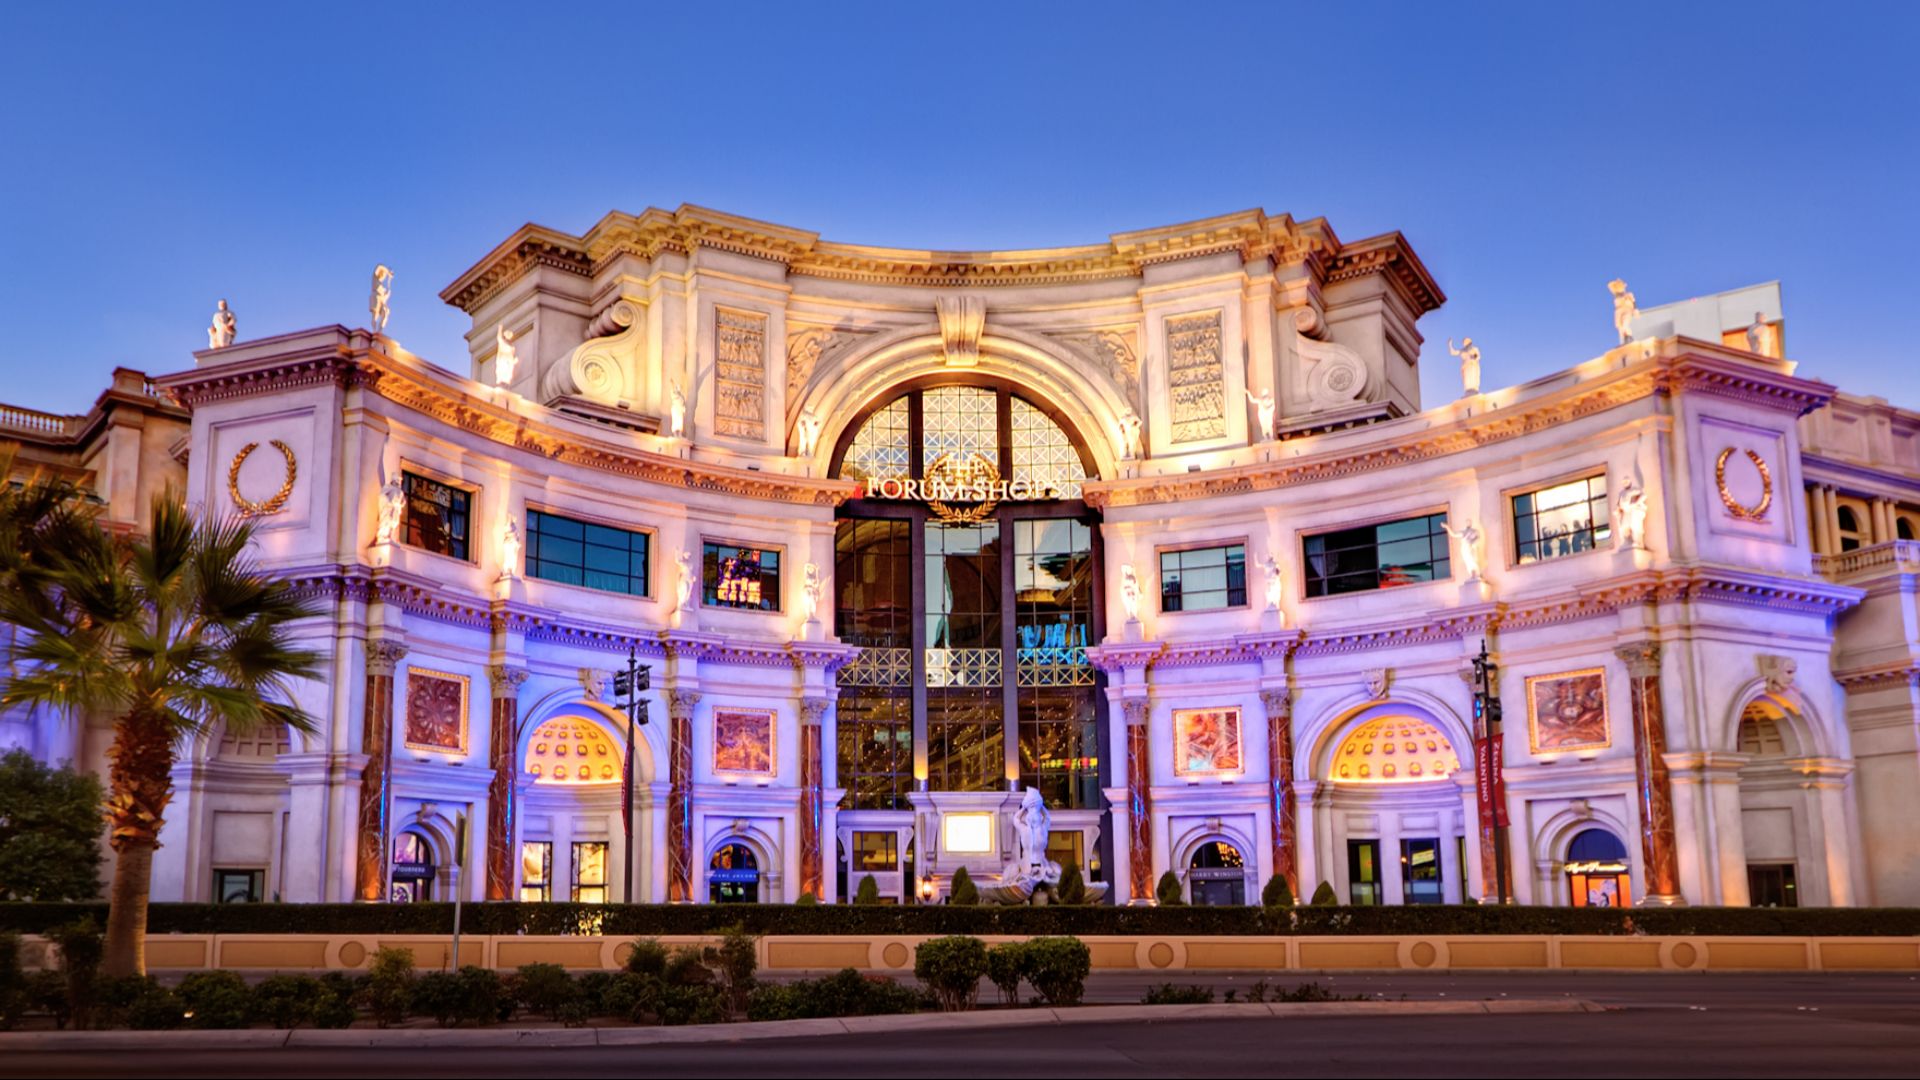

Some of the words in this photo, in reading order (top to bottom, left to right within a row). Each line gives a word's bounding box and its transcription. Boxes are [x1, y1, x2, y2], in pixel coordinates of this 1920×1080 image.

[942, 457, 986, 476] THE
[866, 476, 966, 501] FORUM
[973, 477, 1063, 501] SHOPS
[1480, 745, 1489, 803] VALENTINO
